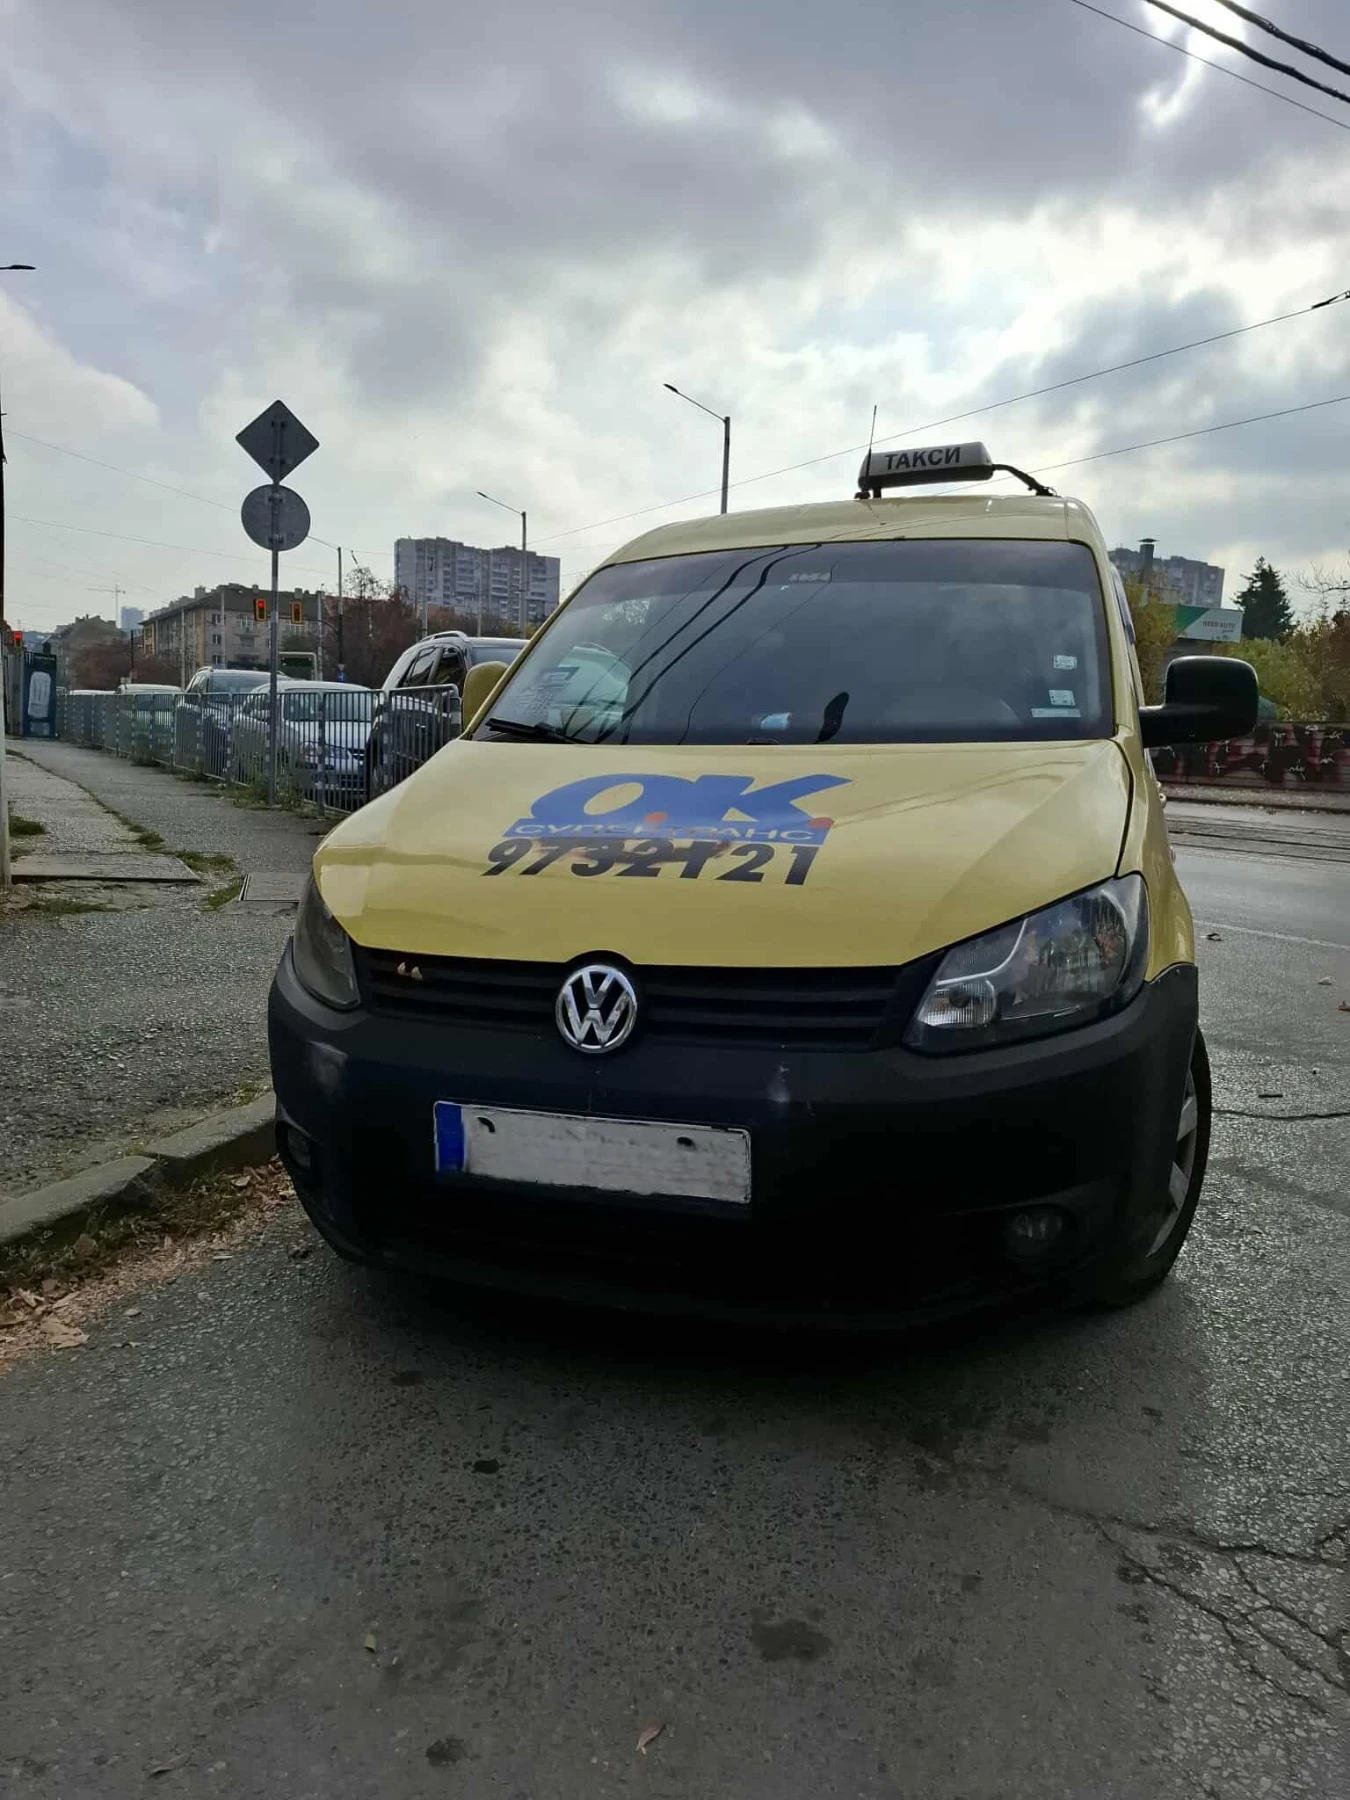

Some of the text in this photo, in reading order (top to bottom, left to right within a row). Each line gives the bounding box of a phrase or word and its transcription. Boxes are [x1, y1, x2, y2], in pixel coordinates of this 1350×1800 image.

[884, 446, 961, 471] ТАКСИ
[481, 837, 819, 886] 9732121
[560, 967, 632, 1048] VW
